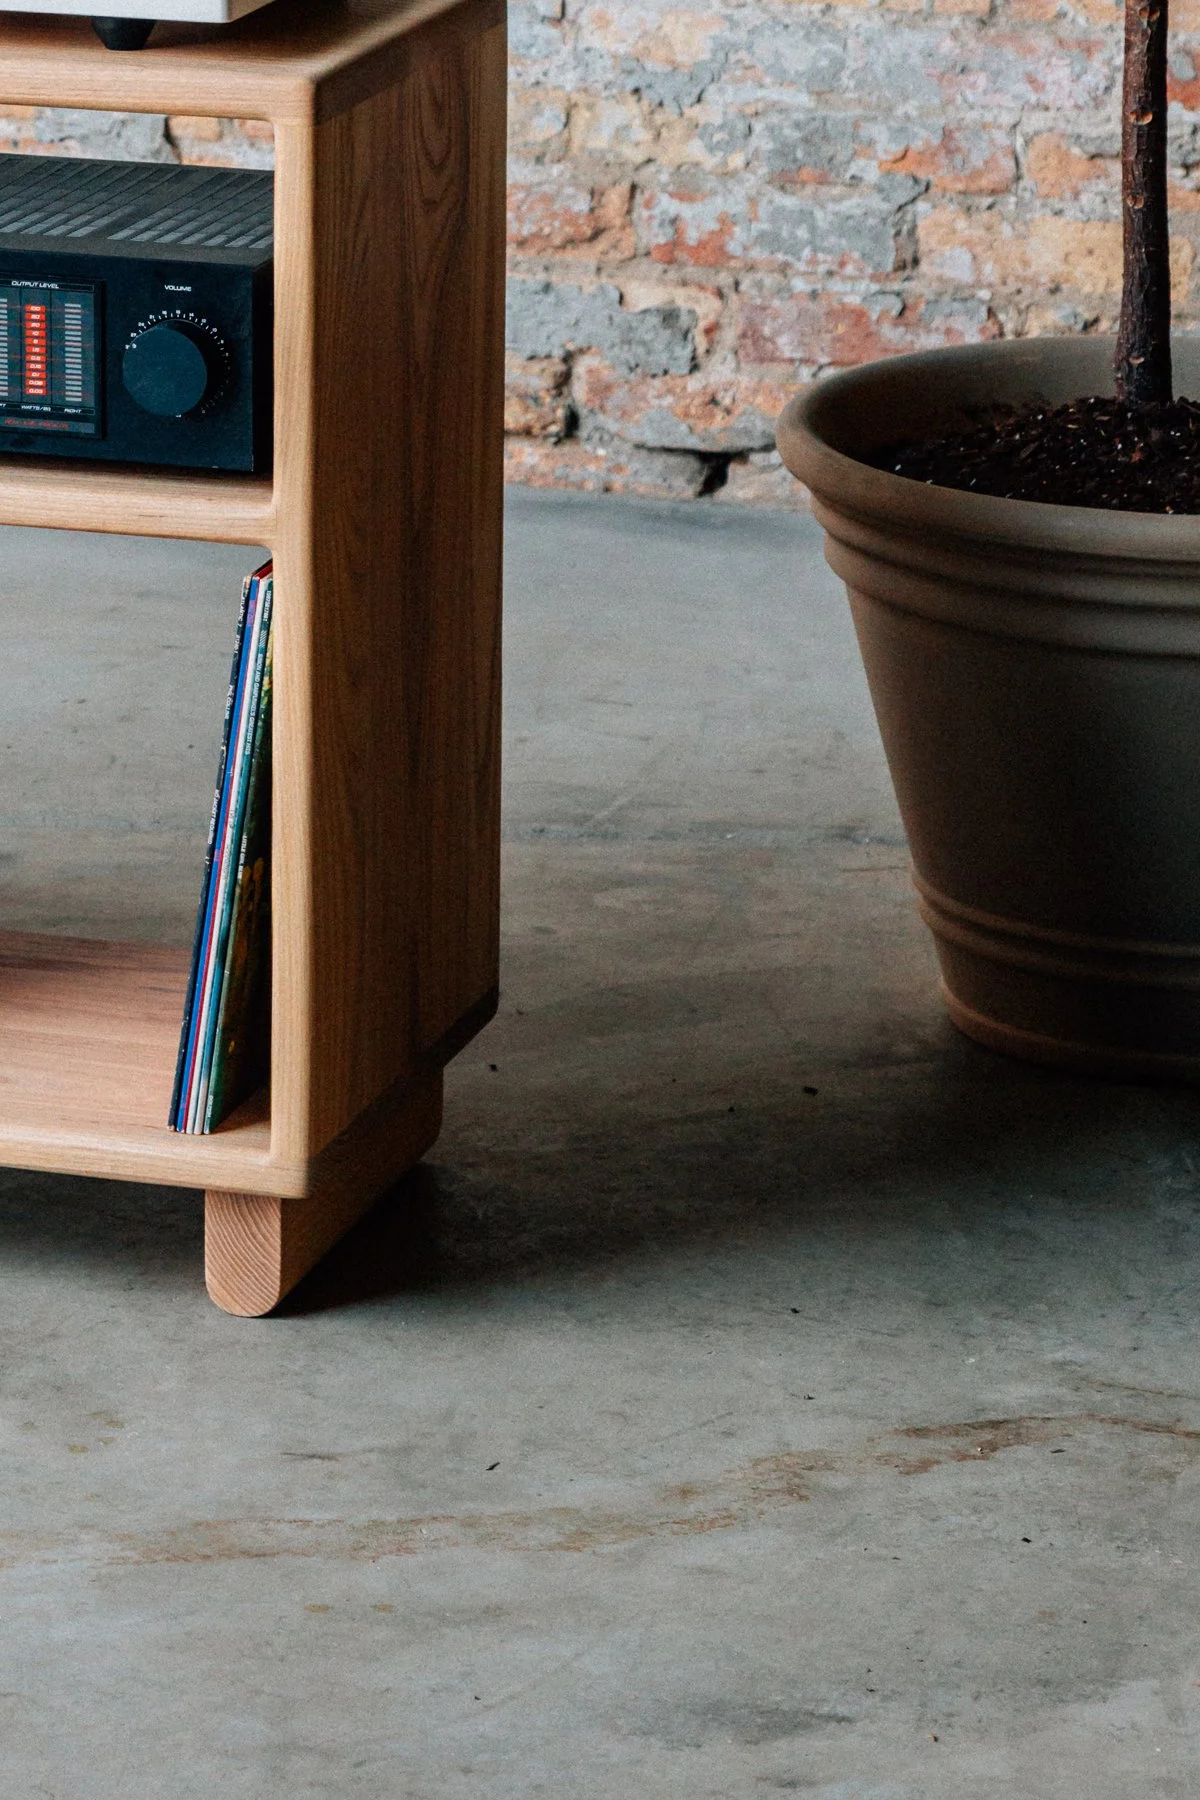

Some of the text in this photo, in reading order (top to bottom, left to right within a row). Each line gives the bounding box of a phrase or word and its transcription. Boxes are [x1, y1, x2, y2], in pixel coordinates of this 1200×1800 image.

[11, 279, 61, 290] OUTPUT LEVEL
[164, 284, 192, 292] VOLUME
[225, 697, 233, 720] COLLINS
[244, 653, 264, 755] SIMON AND GARFUNKEL'S GREATEST HITS
[208, 789, 220, 845] NO JACKET REQUIRED
[240, 834, 248, 852] LITTLE
